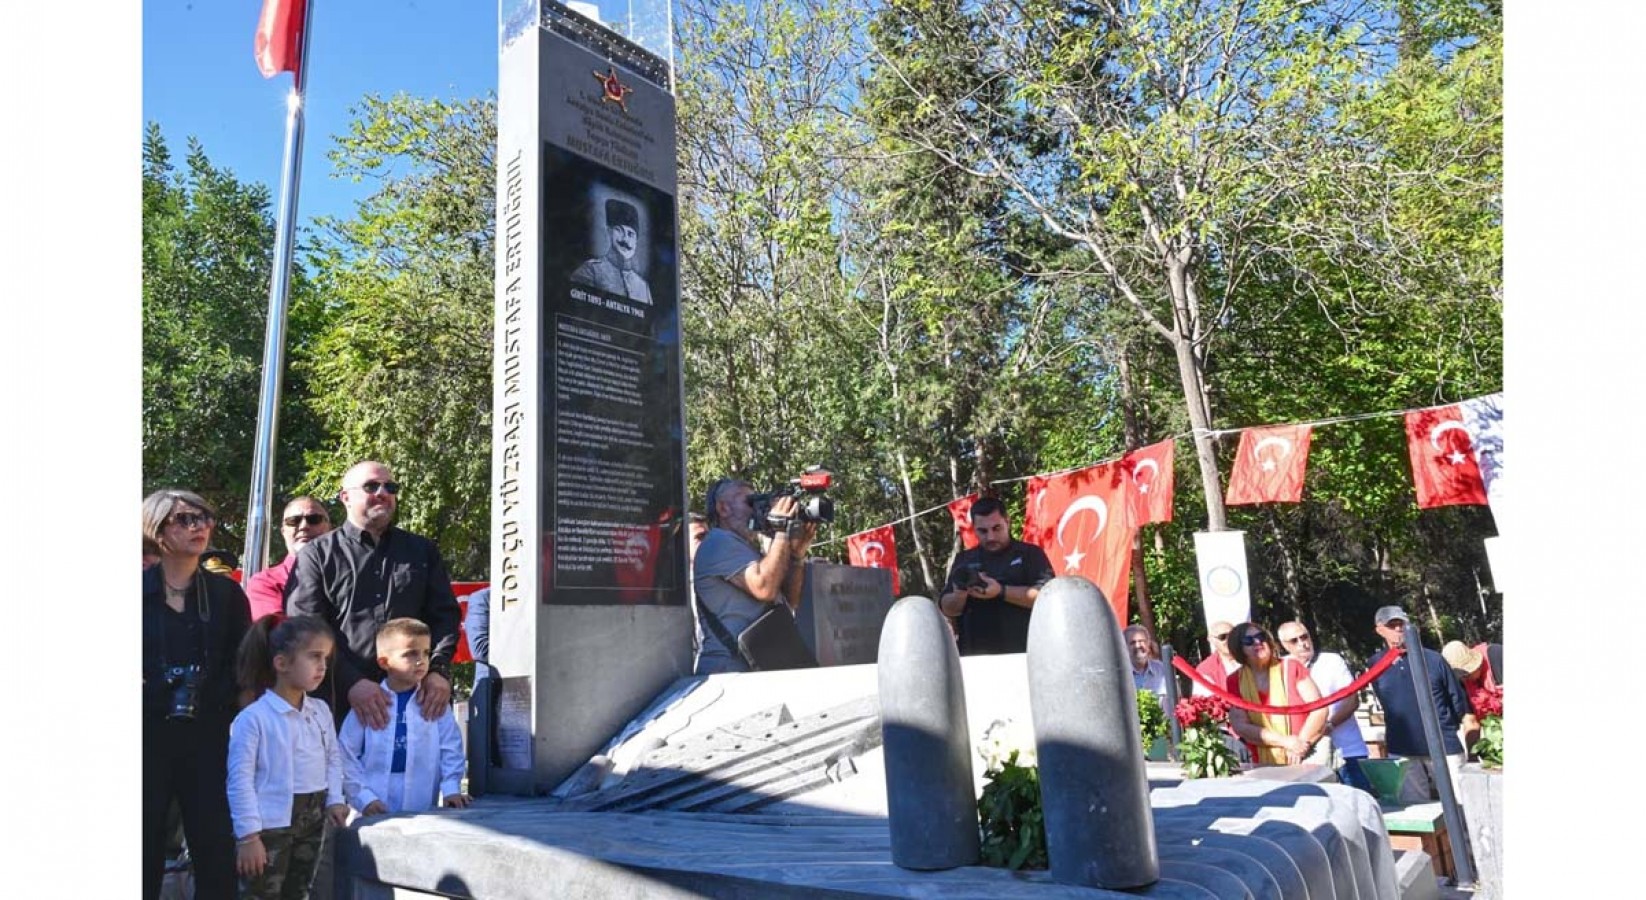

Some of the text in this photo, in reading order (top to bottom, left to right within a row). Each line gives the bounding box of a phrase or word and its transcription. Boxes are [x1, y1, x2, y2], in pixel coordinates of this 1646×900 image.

[566, 134, 608, 162] MUSTAFA
[605, 298, 630, 314] ANTALYA
[500, 148, 525, 612] TOPÇU YÜZBAŞI MUSTAFA ERTUĞRUL
